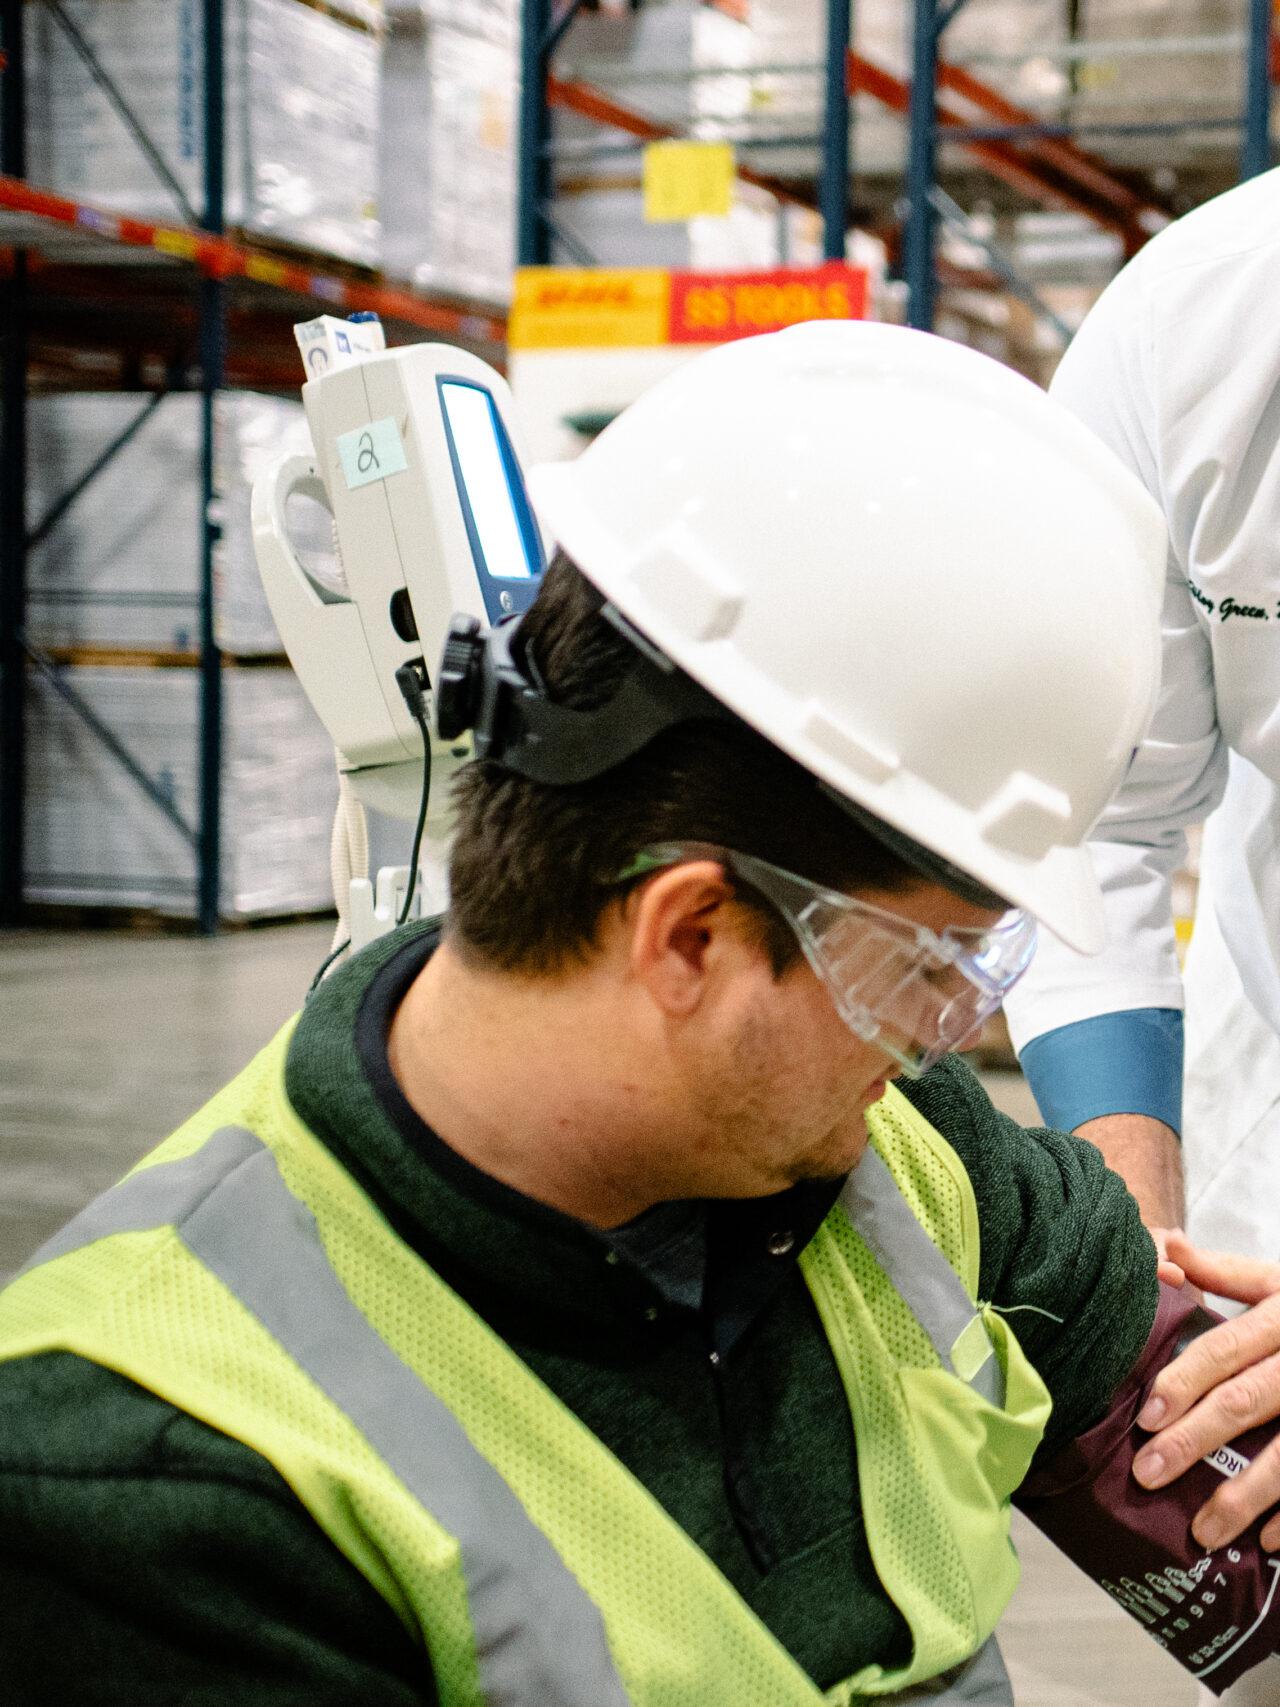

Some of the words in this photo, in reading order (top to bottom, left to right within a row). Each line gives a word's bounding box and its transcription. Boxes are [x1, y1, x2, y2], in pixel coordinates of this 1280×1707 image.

[357, 432, 380, 473] 2
[1189, 1604, 1204, 1619] 9
[1201, 1591, 1216, 1605] 8
[1213, 1571, 1227, 1587] 7
[1227, 1548, 1241, 1563] 6
